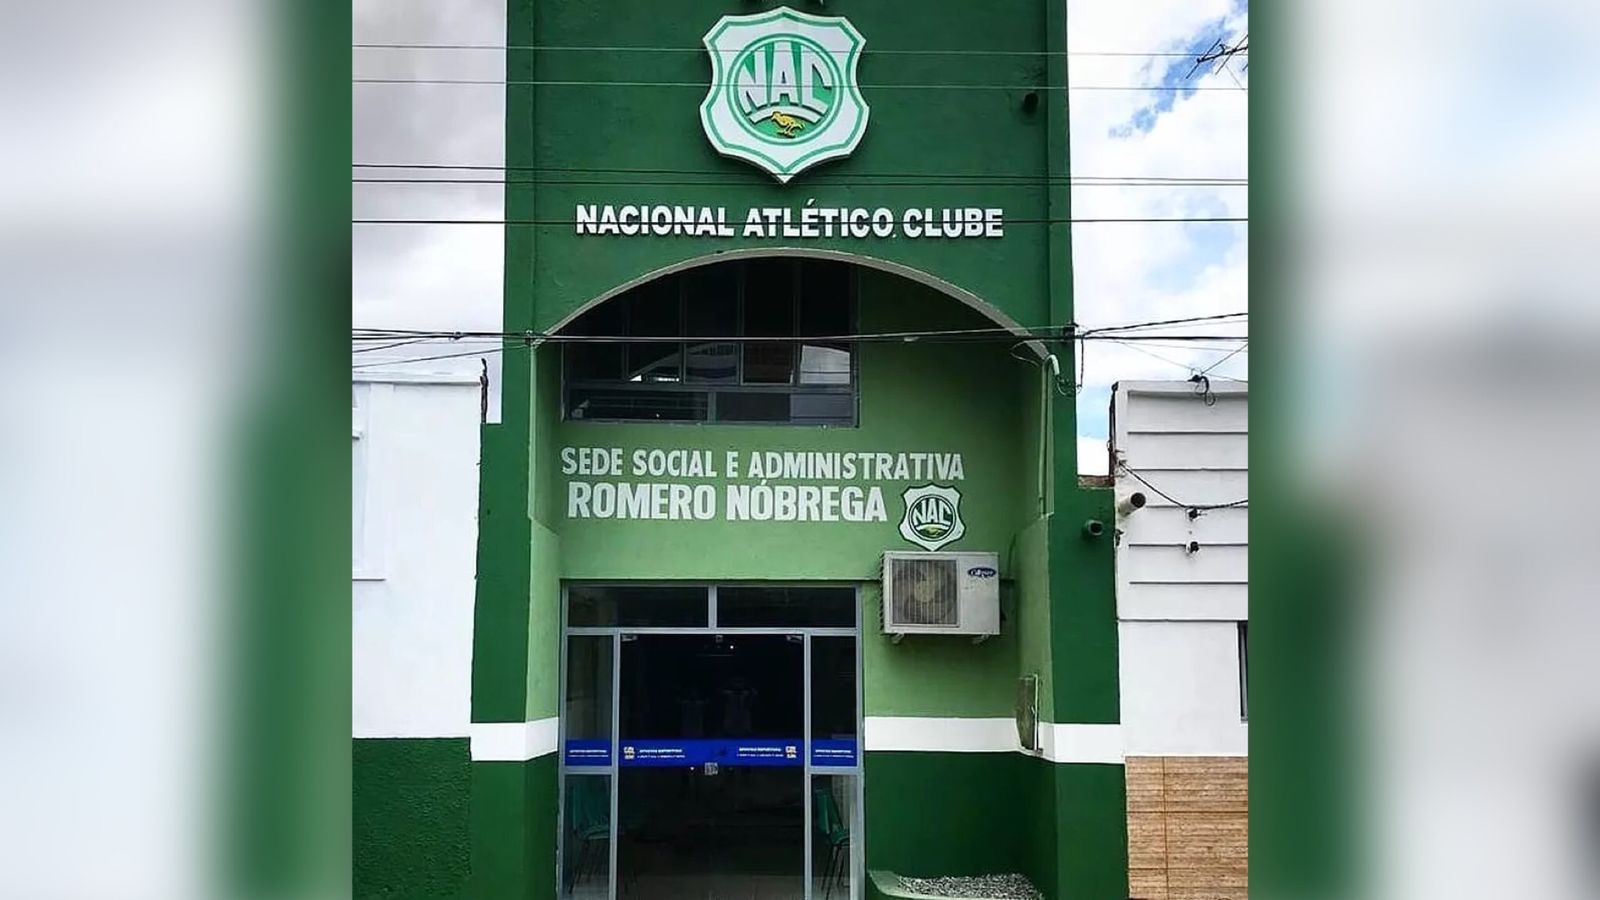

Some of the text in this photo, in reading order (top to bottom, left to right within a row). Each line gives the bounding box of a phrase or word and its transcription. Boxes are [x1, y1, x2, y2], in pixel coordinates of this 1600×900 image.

[738, 41, 832, 116] NAC
[576, 199, 1004, 238] NACIONAL ATLÉTICO CLUBE
[561, 447, 965, 480] SEDE SOCIAL E ADMINISTRATIVA
[567, 478, 888, 522] ROMERO NÓBREGA
[912, 497, 953, 527] NAC
